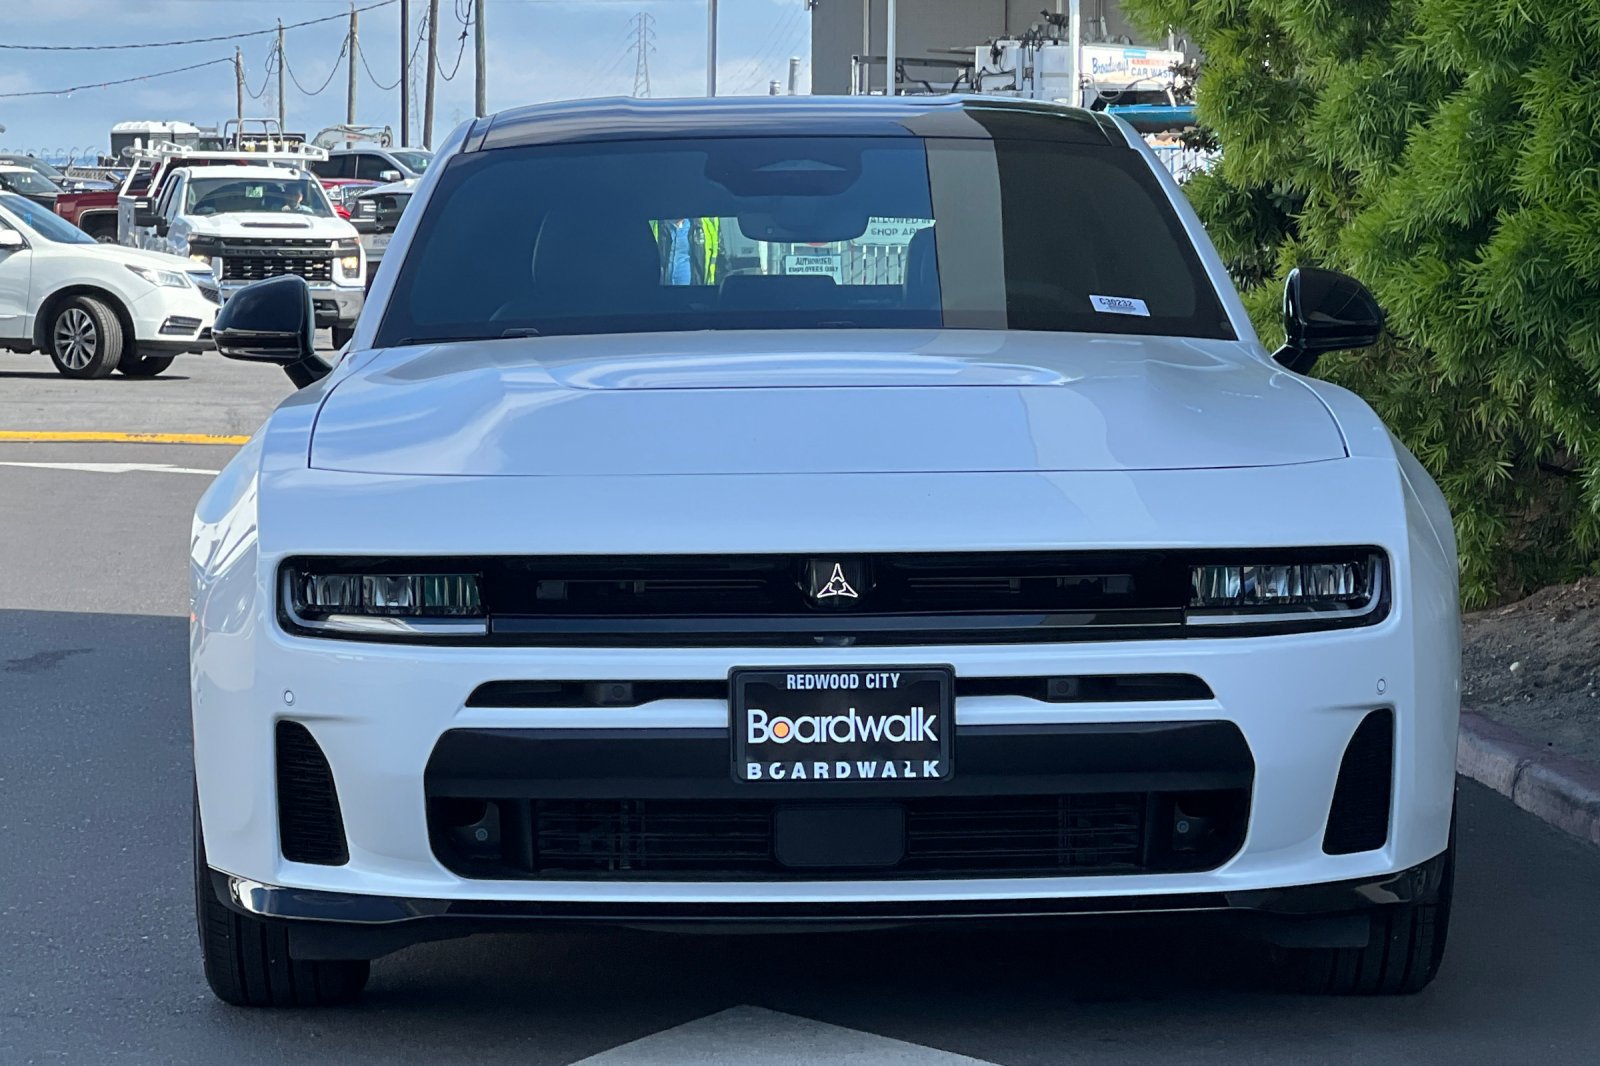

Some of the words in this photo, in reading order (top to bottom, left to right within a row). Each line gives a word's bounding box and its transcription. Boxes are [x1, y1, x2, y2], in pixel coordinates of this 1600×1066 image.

[1131, 67, 1148, 76] CAR
[870, 228, 899, 236] SHOP
[787, 673, 860, 689] REDWOOD
[866, 673, 900, 689] CITY
[747, 707, 938, 744] Boardwalk
[747, 760, 940, 780] BOARDWALK
